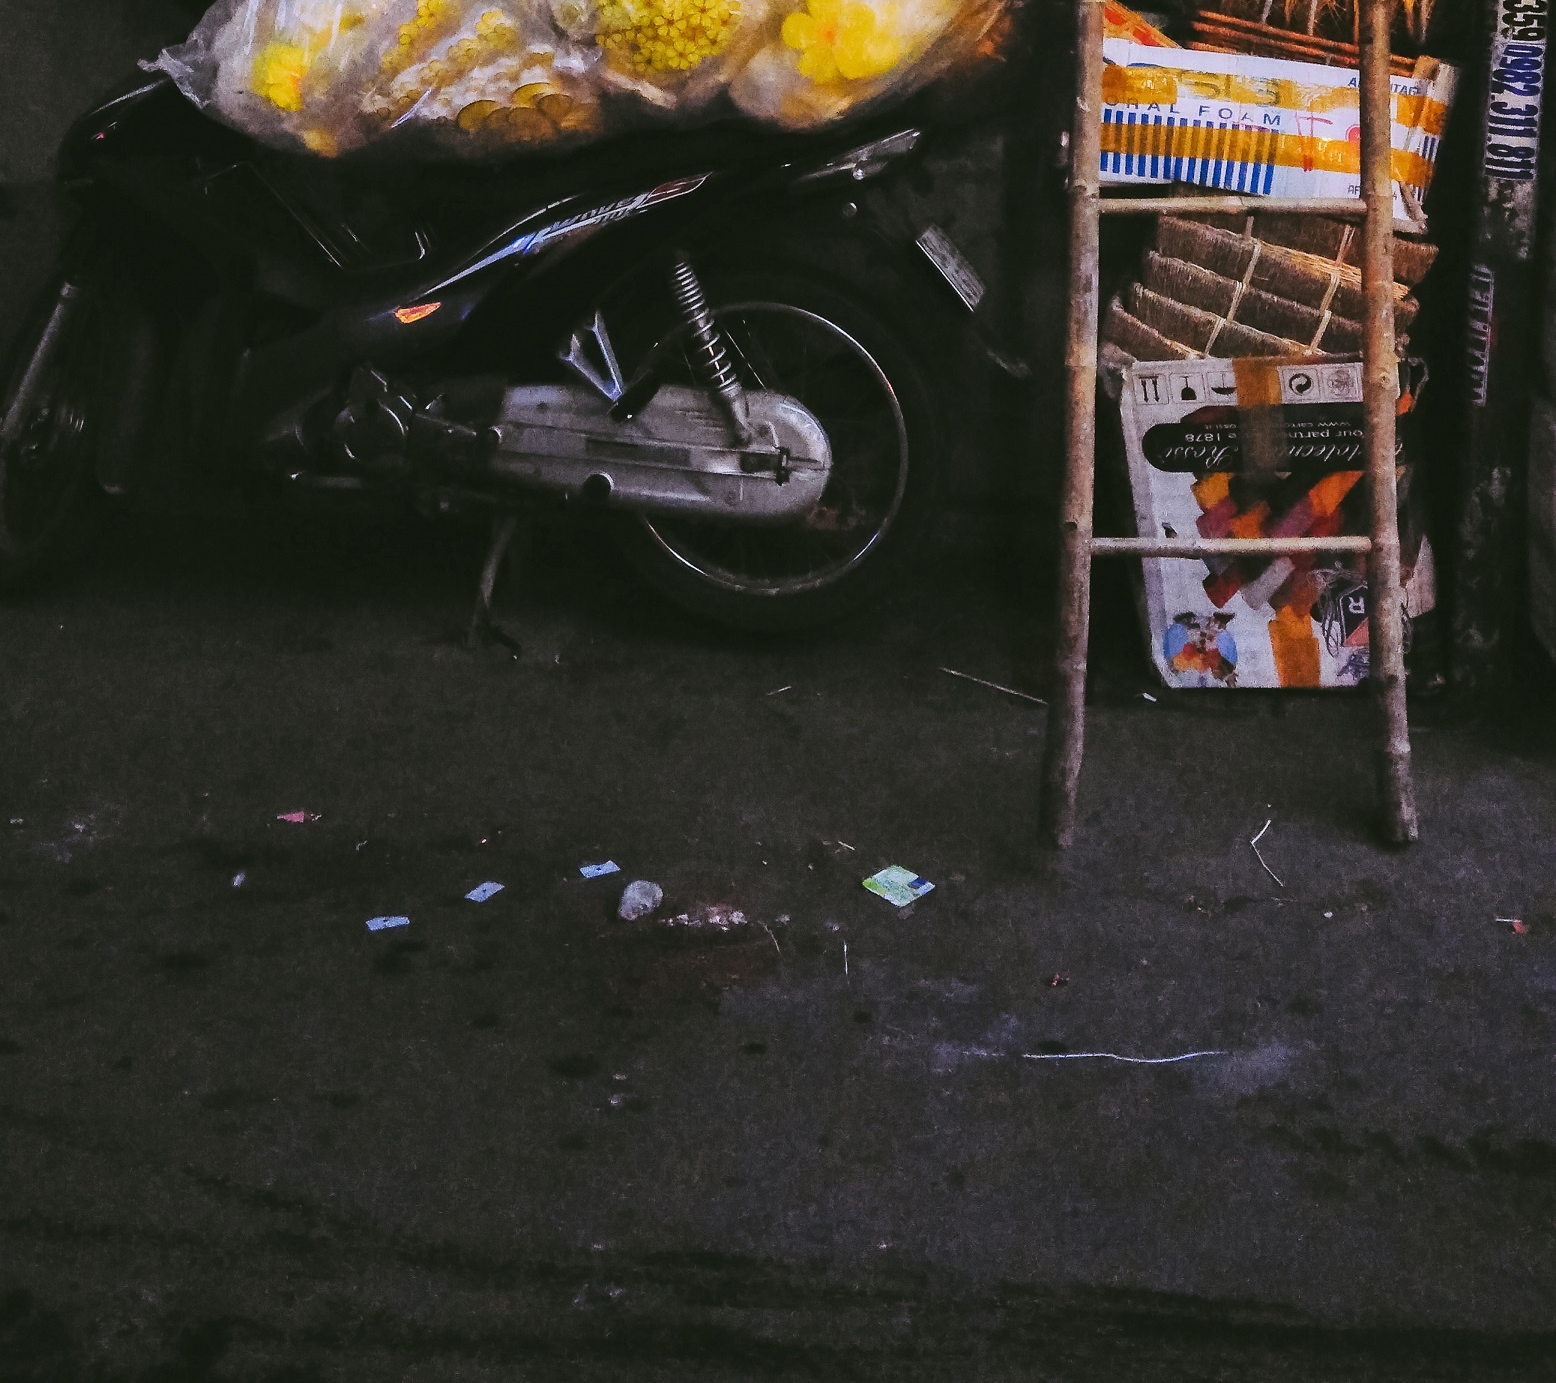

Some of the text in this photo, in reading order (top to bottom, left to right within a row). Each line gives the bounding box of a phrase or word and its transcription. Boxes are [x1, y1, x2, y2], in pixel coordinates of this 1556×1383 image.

[1199, 103, 1282, 126] FOAM
[1485, 44, 1544, 180] 0982.311.811
[1184, 432, 1222, 443] 1878
